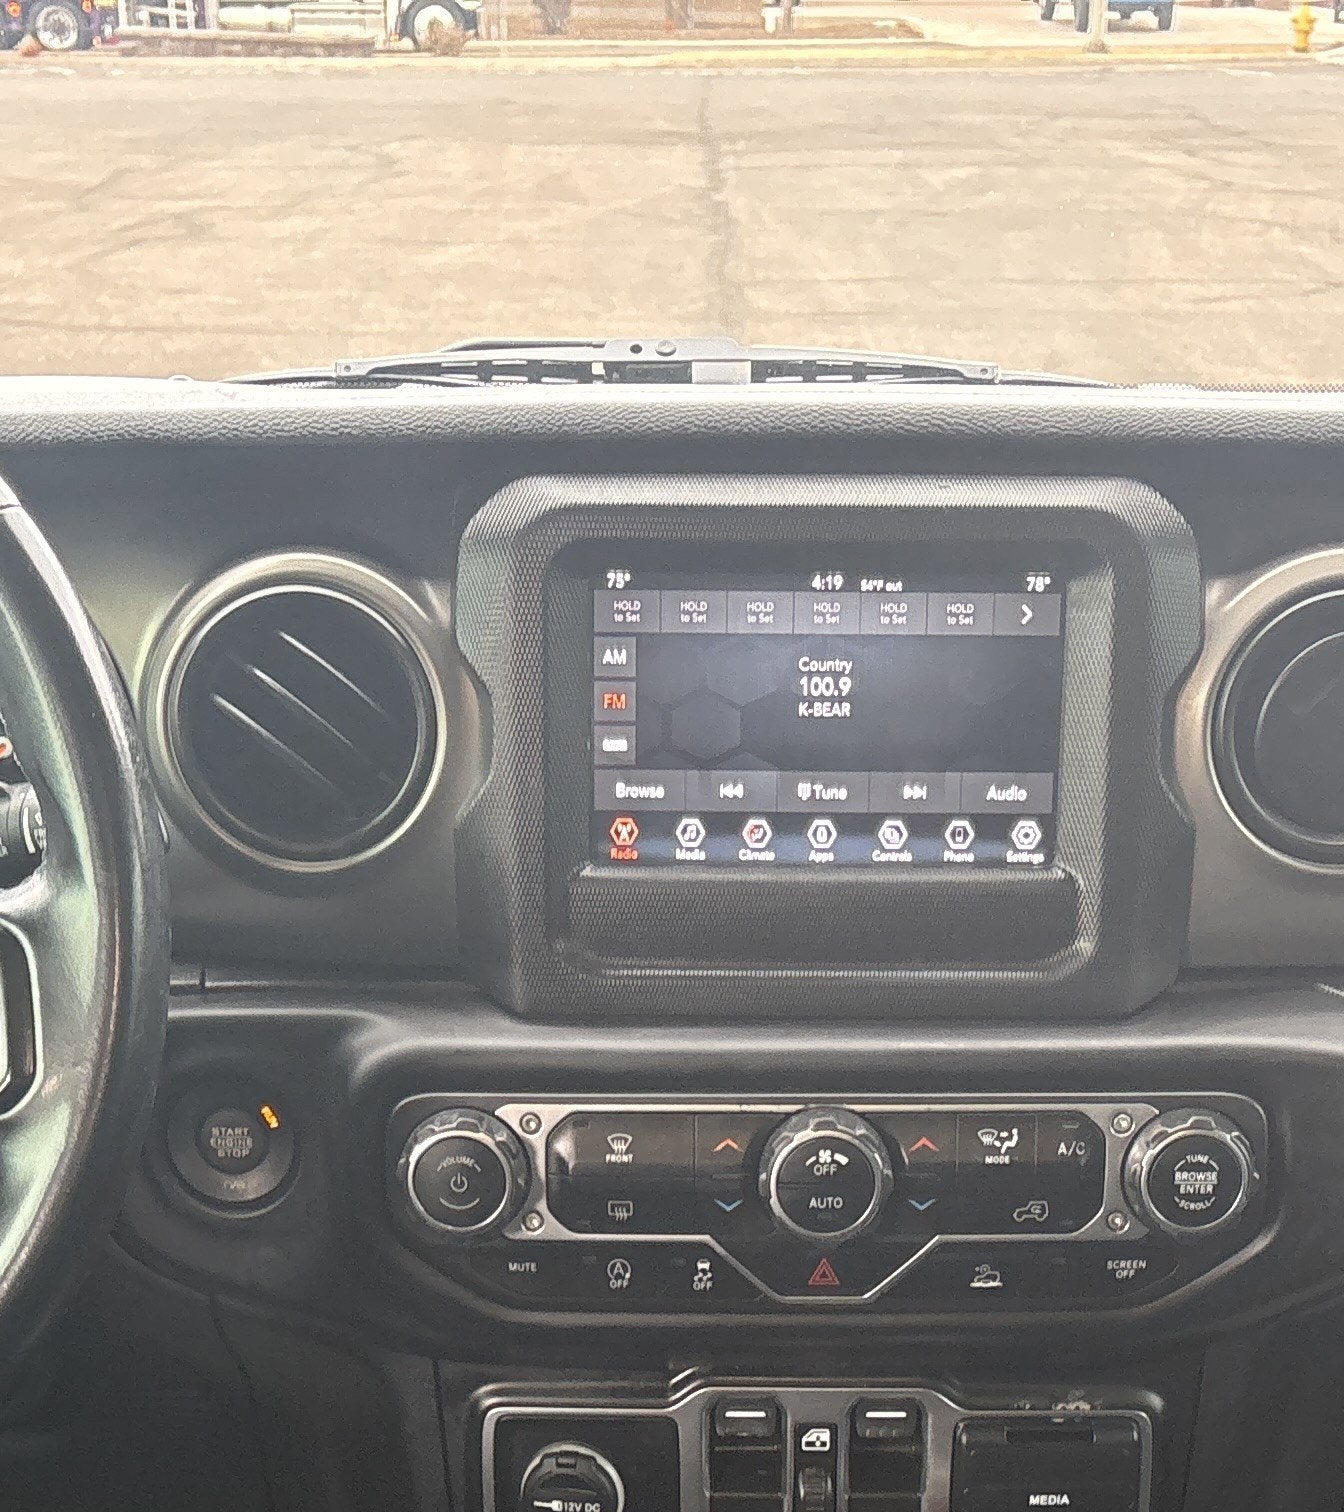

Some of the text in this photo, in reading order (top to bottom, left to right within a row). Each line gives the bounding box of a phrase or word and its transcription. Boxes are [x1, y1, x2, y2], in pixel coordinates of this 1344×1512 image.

[811, 574, 844, 591] 4:19
[613, 600, 641, 612] HOLD
[679, 601, 708, 612] HOLD
[746, 601, 775, 613] HOLD
[813, 602, 841, 613] HOLD
[879, 602, 908, 614] HOLD
[946, 602, 975, 614] HOLD
[614, 612, 641, 623] to Set
[680, 613, 707, 624] to Set
[747, 613, 774, 624] to Set
[813, 614, 841, 625] to Set
[880, 614, 907, 625] to Set
[946, 615, 974, 626] to Set
[602, 648, 627, 665] AM
[798, 656, 853, 674] Country
[799, 676, 852, 697] 100.9
[603, 693, 626, 710] FM
[798, 701, 851, 718] K-BEAR
[615, 781, 1028, 801] Browse Tune Audio
[610, 847, 638, 860] Radio
[675, 848, 706, 861] Media
[808, 849, 835, 863] Apps
[943, 850, 975, 863] Phone
[211, 1127, 249, 1136] START
[217, 1147, 250, 1158] STOP
[1056, 1141, 1086, 1156] A/C
[441, 1155, 476, 1169] VOLUME
[605, 1153, 634, 1164] FRONT
[984, 1154, 1011, 1165] MODE
[1185, 1153, 1210, 1165] TUNE
[813, 1163, 838, 1176] OFF
[1174, 1171, 1218, 1182] BROWSE
[1179, 1184, 1214, 1195] ENTER
[809, 1196, 844, 1209] AUTO
[1178, 1199, 1211, 1211] SCROLL
[508, 1262, 537, 1273] MUTE
[1106, 1259, 1147, 1271] SCREEN
[1115, 1268, 1136, 1280] OFF
[609, 1279, 629, 1289] OFF
[692, 1280, 713, 1292] OFF
[1028, 1493, 1070, 1506] MEDIA
[563, 1501, 582, 1512] 12V
